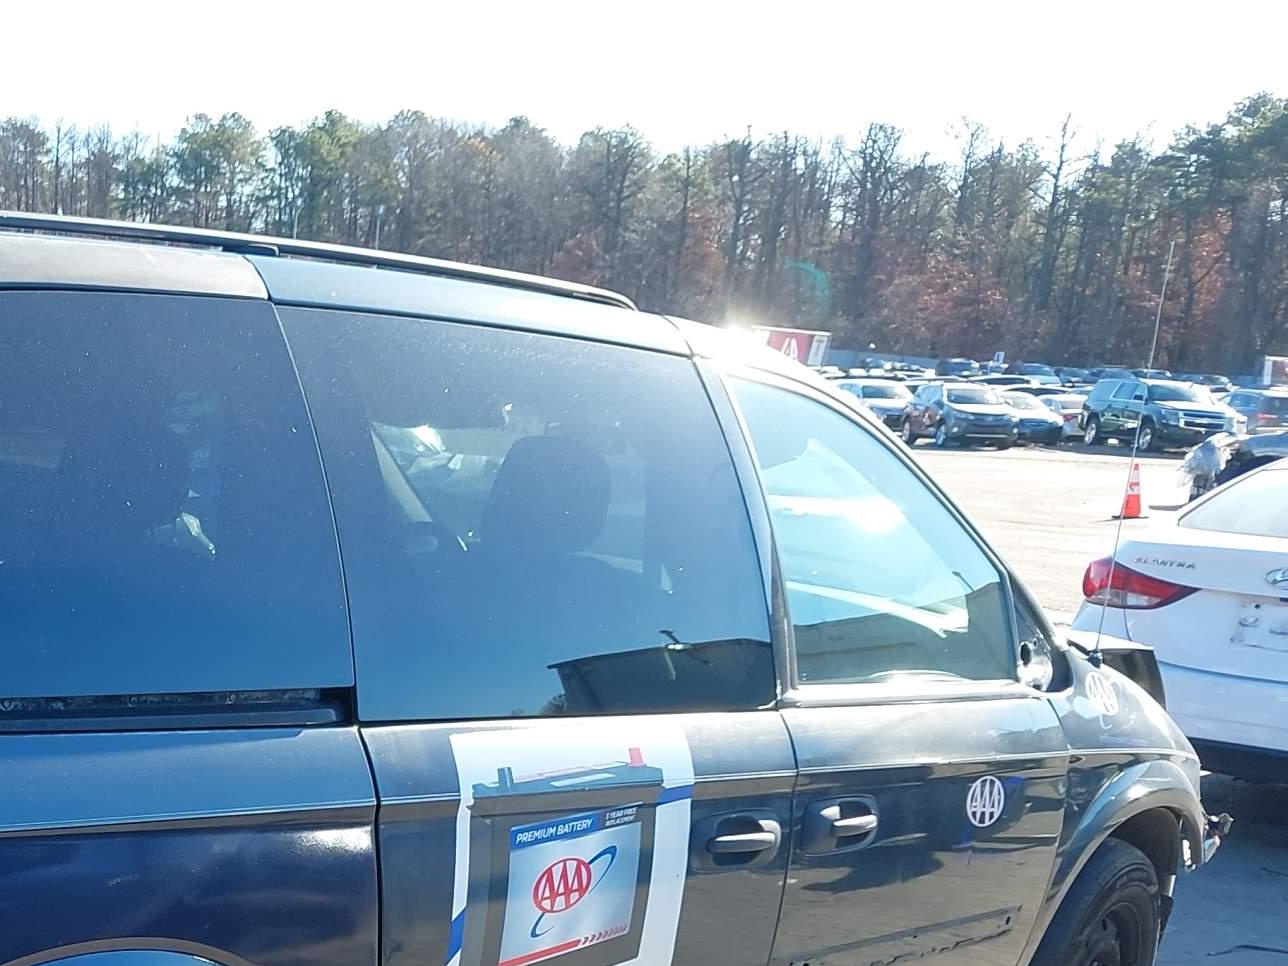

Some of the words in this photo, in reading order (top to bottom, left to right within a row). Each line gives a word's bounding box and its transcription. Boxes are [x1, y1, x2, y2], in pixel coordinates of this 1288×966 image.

[624, 806, 638, 815] FREE
[966, 775, 1004, 827] AAA
[516, 826, 557, 845] PREMIUM
[557, 818, 594, 836] BATTERY
[533, 857, 592, 913] AAA
